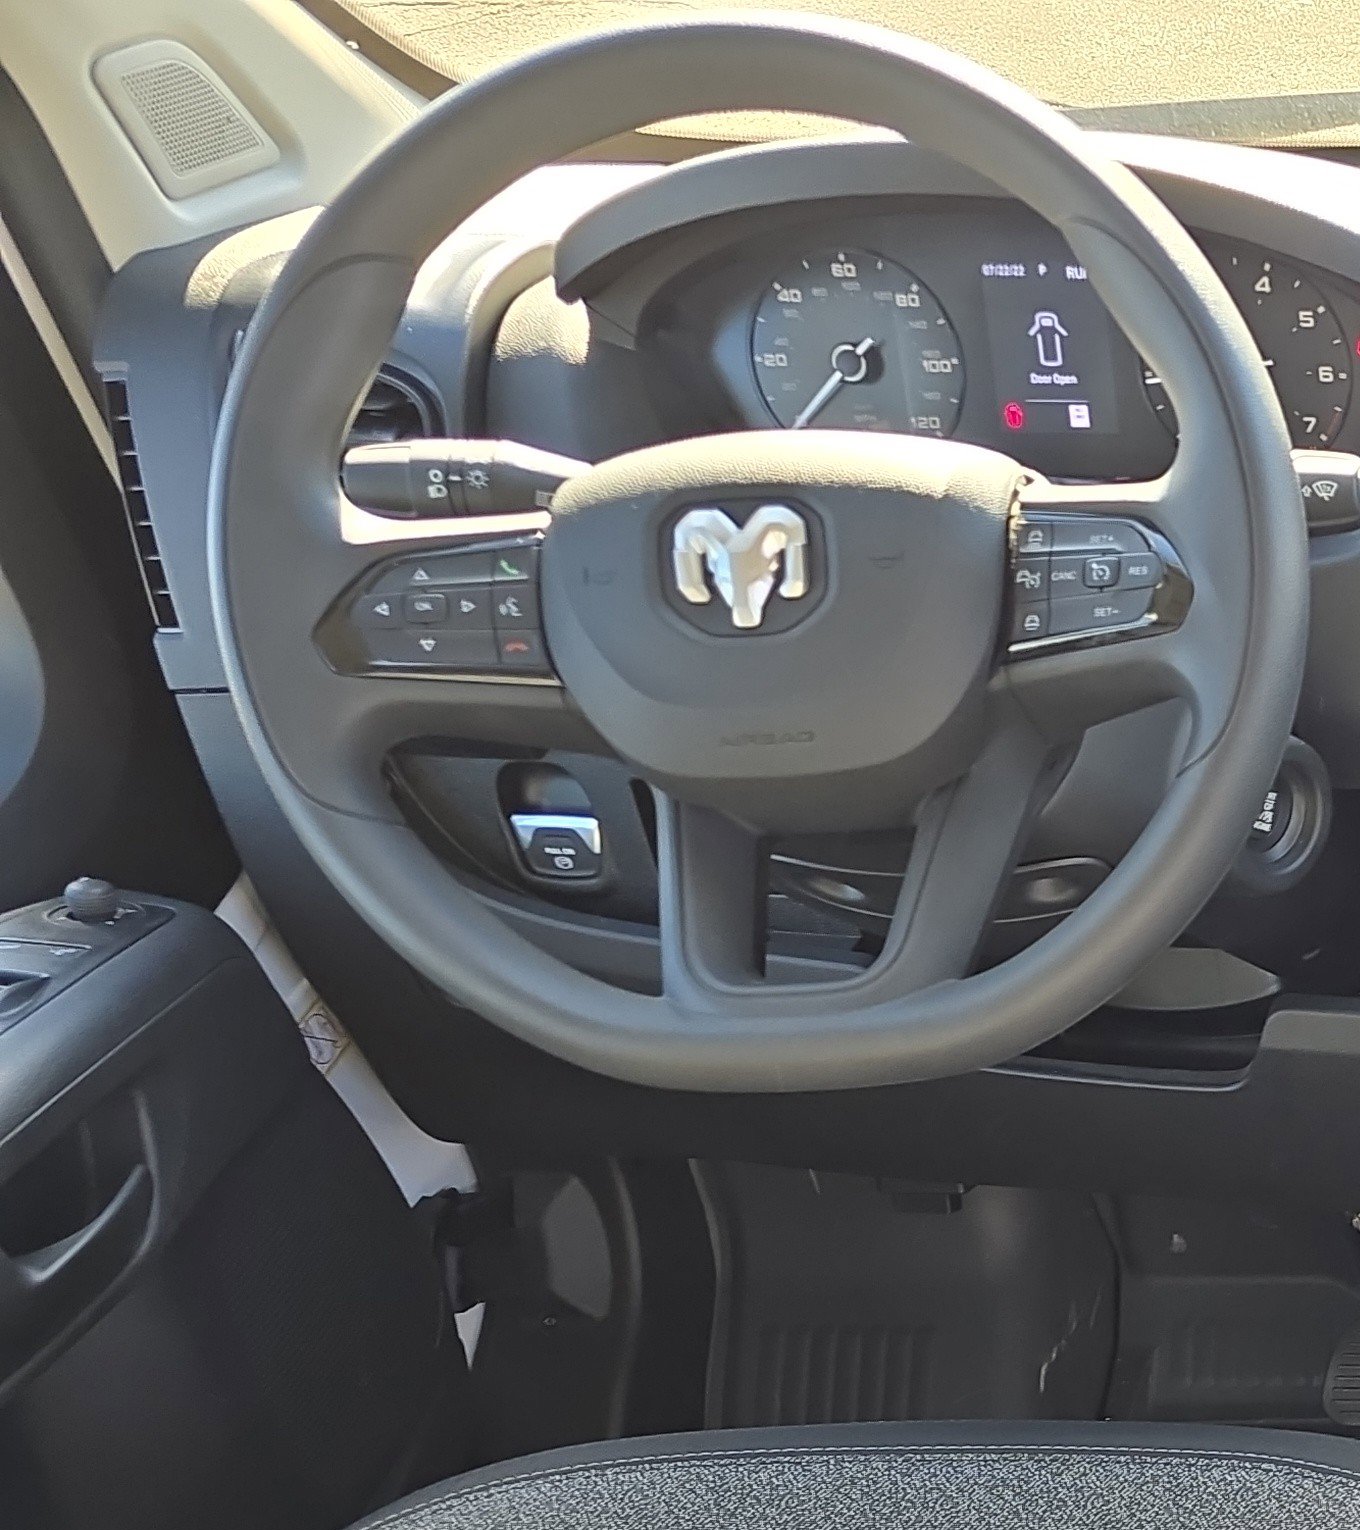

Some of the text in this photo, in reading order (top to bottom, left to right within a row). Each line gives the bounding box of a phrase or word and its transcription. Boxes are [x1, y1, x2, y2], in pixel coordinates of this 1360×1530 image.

[831, 263, 857, 277] 60
[1255, 276, 1271, 293] 4
[777, 289, 803, 303] 40
[1299, 311, 1315, 328] 5
[763, 354, 788, 367] 20
[923, 359, 952, 373] 100
[1318, 366, 1334, 383] 6
[911, 416, 941, 429] 120
[1302, 417, 1317, 433] 7
[1128, 566, 1149, 576] RES
